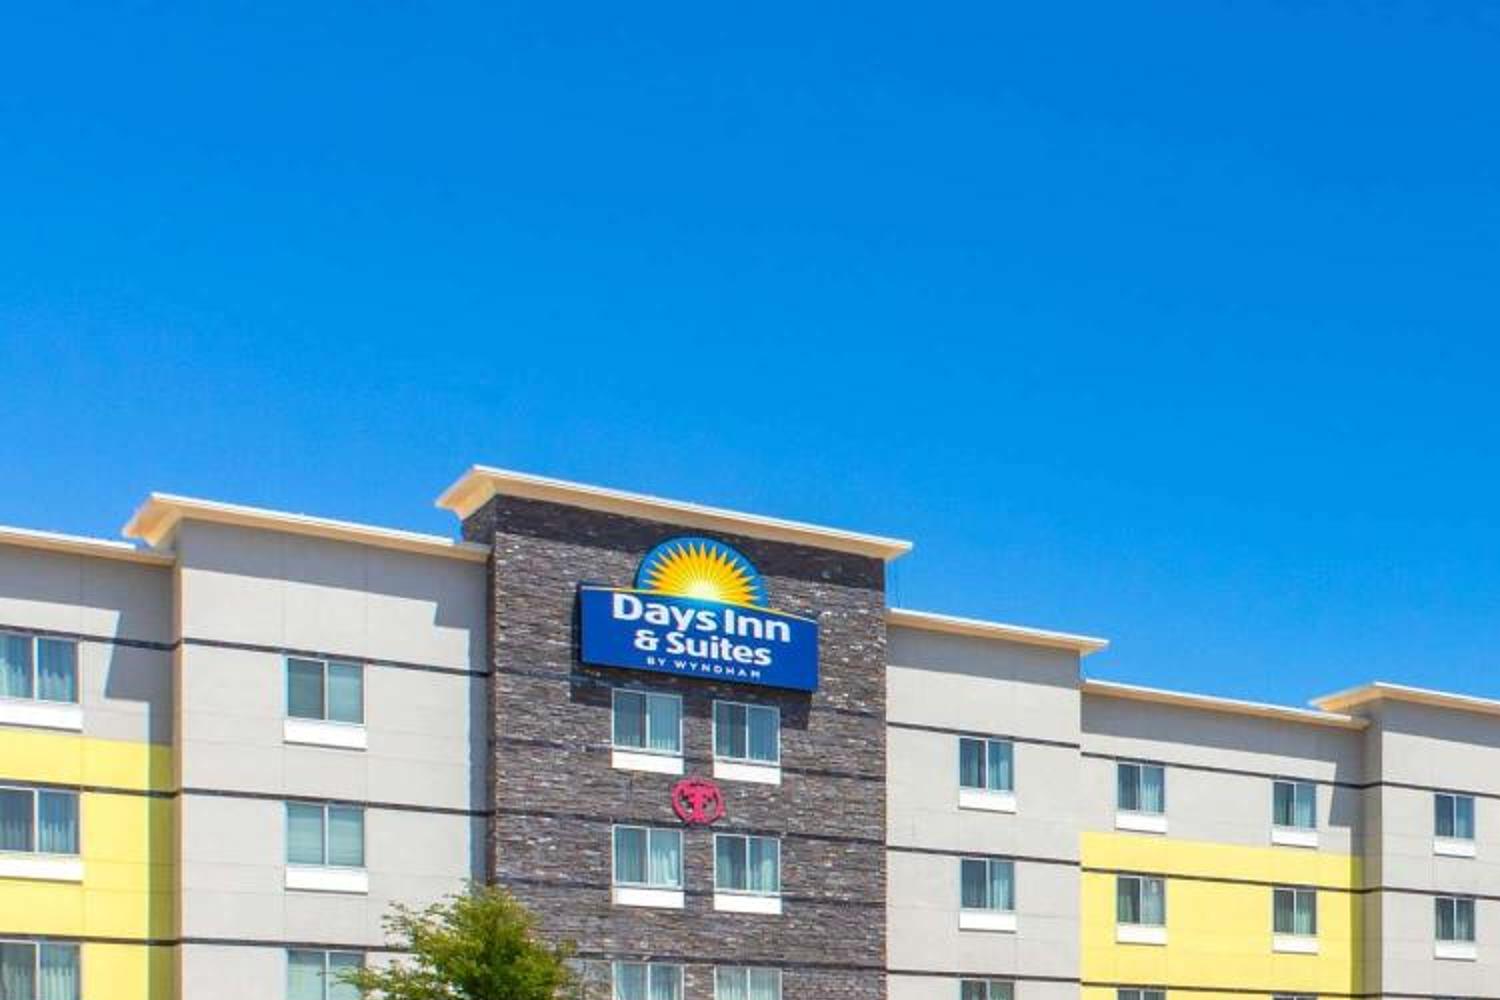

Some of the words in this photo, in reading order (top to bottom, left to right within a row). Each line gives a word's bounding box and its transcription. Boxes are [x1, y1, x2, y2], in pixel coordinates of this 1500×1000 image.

[612, 593, 718, 631] Days
[726, 608, 791, 643] Inn
[634, 629, 659, 651] &
[666, 632, 772, 666] Suites
[647, 656, 666, 667] BY
[674, 661, 760, 679] WYNDHAM
